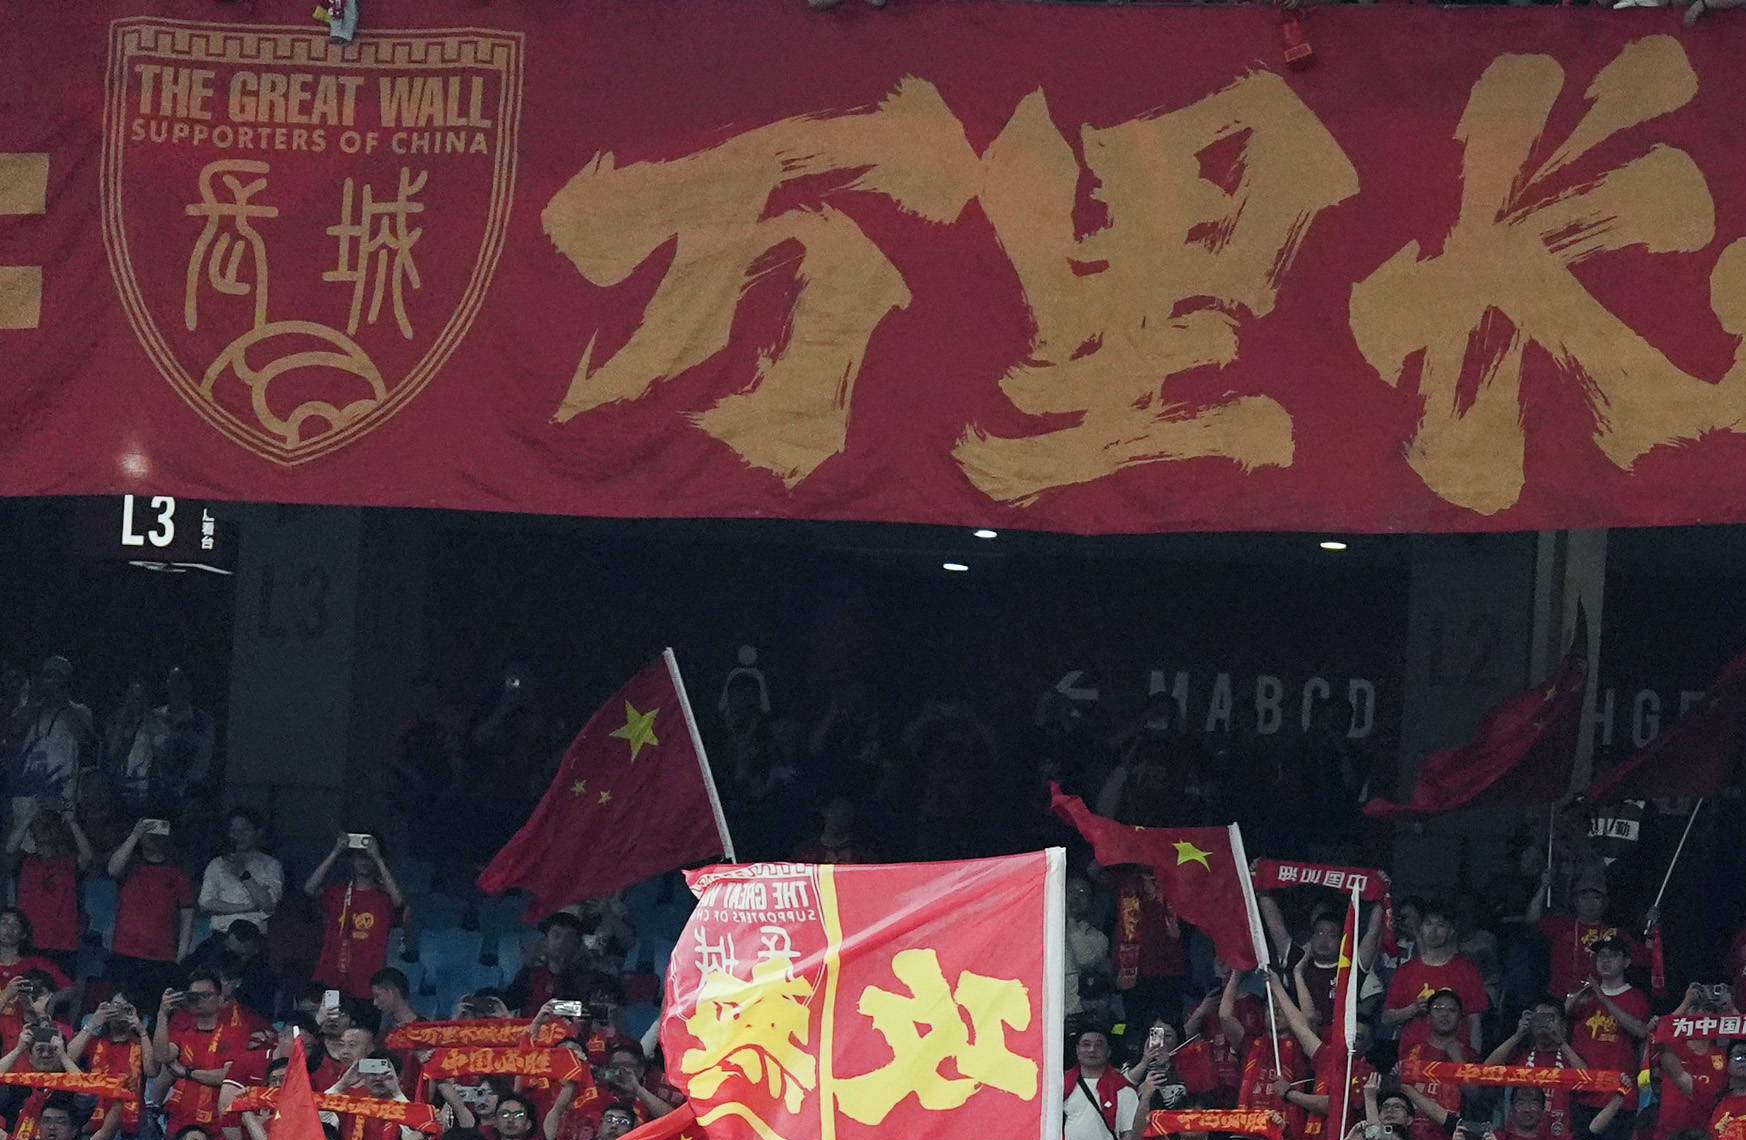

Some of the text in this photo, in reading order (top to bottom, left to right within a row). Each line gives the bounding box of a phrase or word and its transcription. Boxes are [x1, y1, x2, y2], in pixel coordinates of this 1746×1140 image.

[135, 63, 493, 129] THE GREAT WALL
[131, 119, 489, 155] SUPPORTERS OF CHINA
[121, 494, 176, 547] L3
